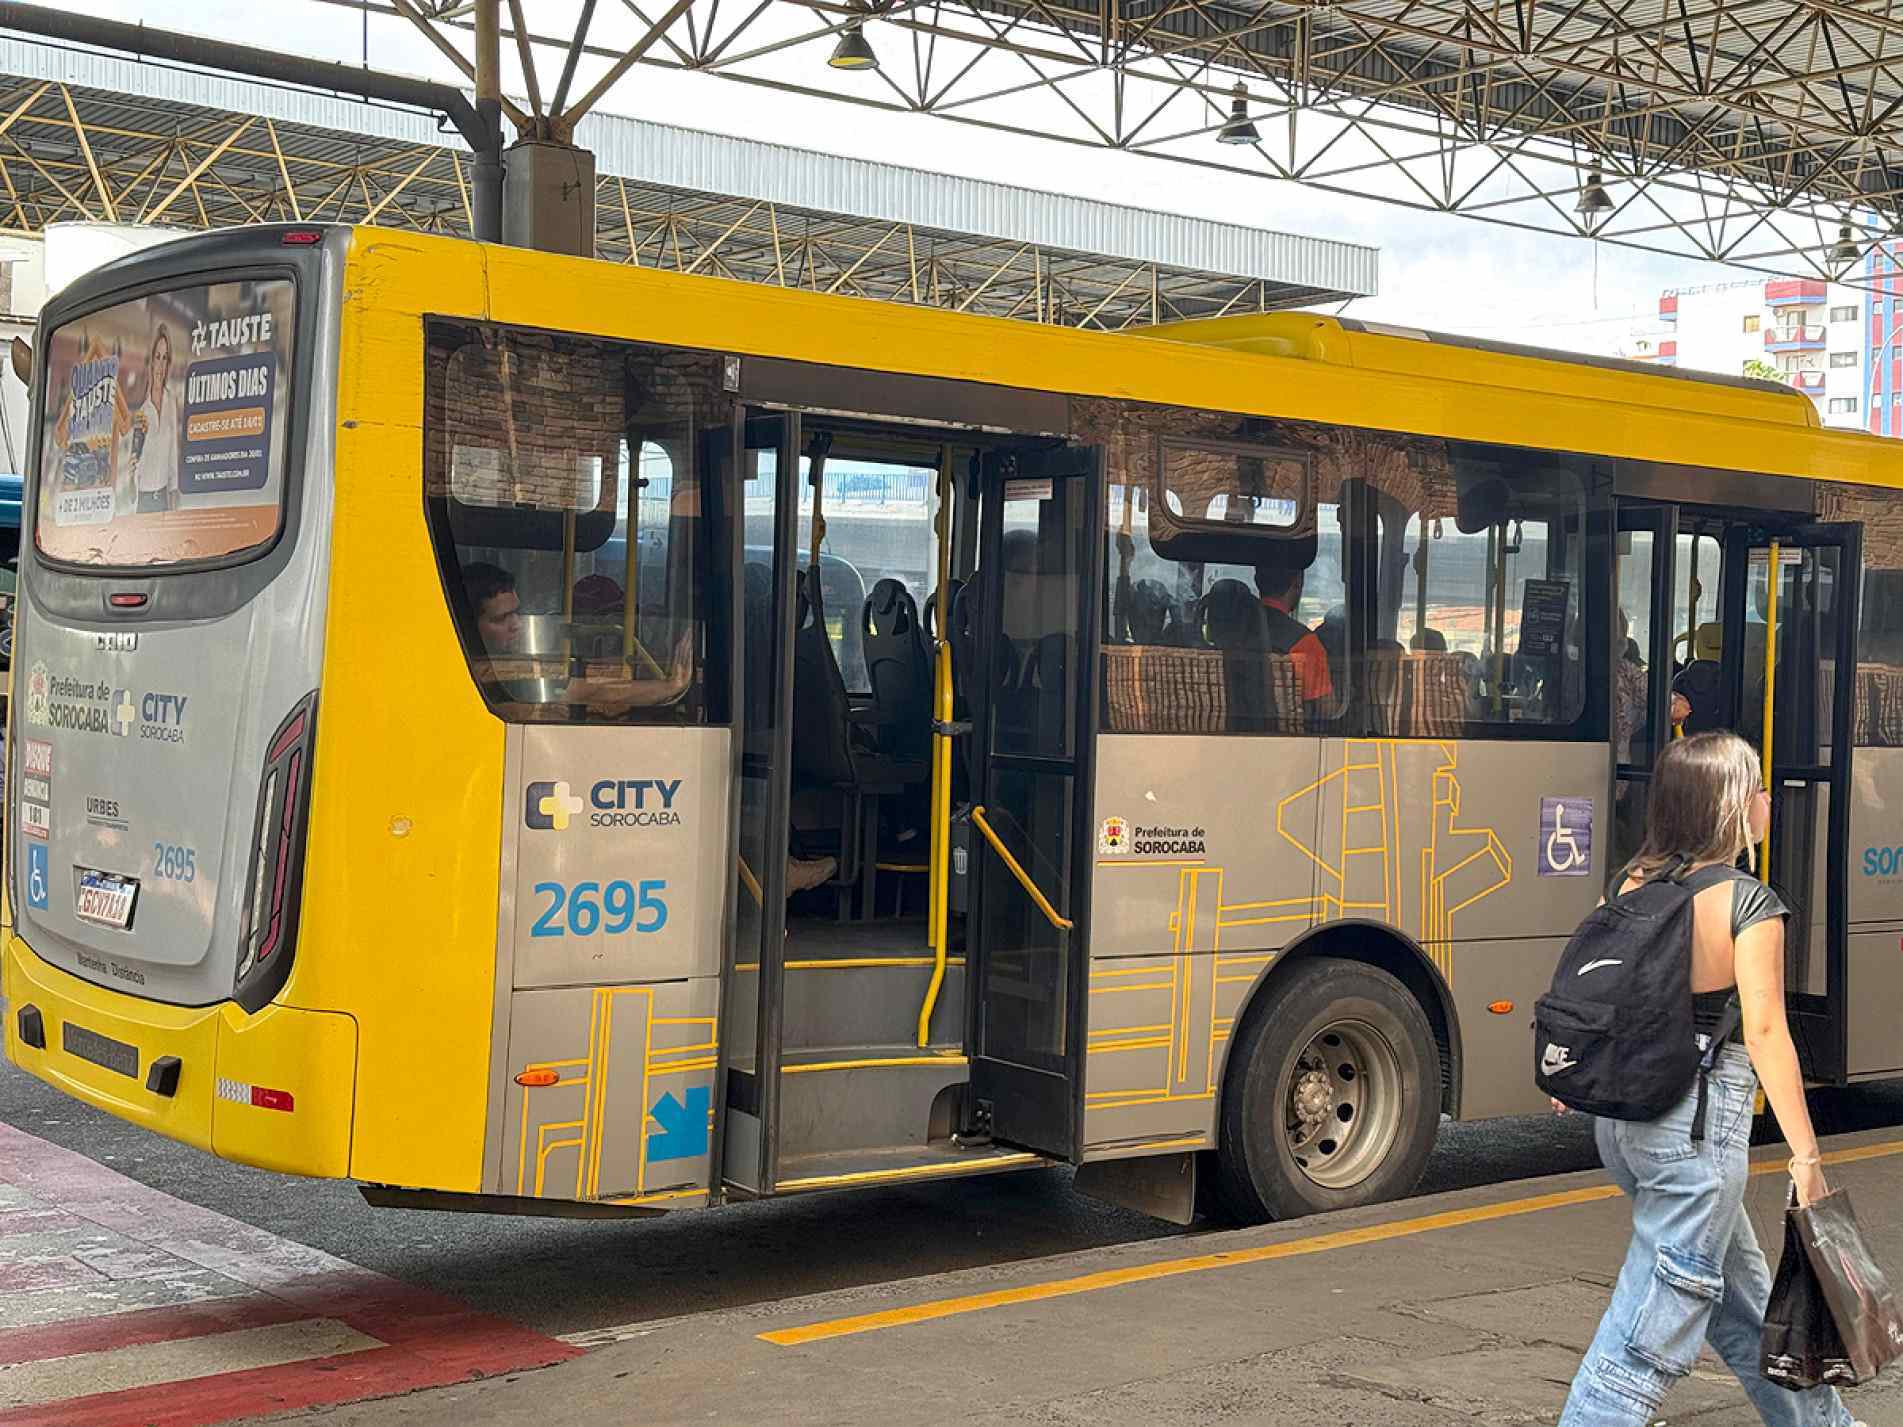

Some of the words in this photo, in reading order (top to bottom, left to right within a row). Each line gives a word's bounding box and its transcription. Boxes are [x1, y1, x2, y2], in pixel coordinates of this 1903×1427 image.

[209, 313, 272, 349] TAUSTE
[188, 371, 237, 404] ÚLTIMOS
[238, 366, 268, 398] DIAS
[50, 675, 95, 700] Prefeitura
[97, 680, 110, 701] de
[49, 703, 109, 734] SOROCABA
[142, 692, 188, 725] CITY
[140, 724, 185, 744] SOROCABA
[86, 797, 120, 817] URBES
[590, 780, 683, 809] CITY
[590, 812, 681, 827] SOROCABA
[1135, 826, 1189, 838] Prefeitura
[1192, 826, 1206, 838] de
[1134, 840, 1206, 854] SOROCABA
[154, 842, 195, 882] 2695
[530, 880, 668, 938] 2695
